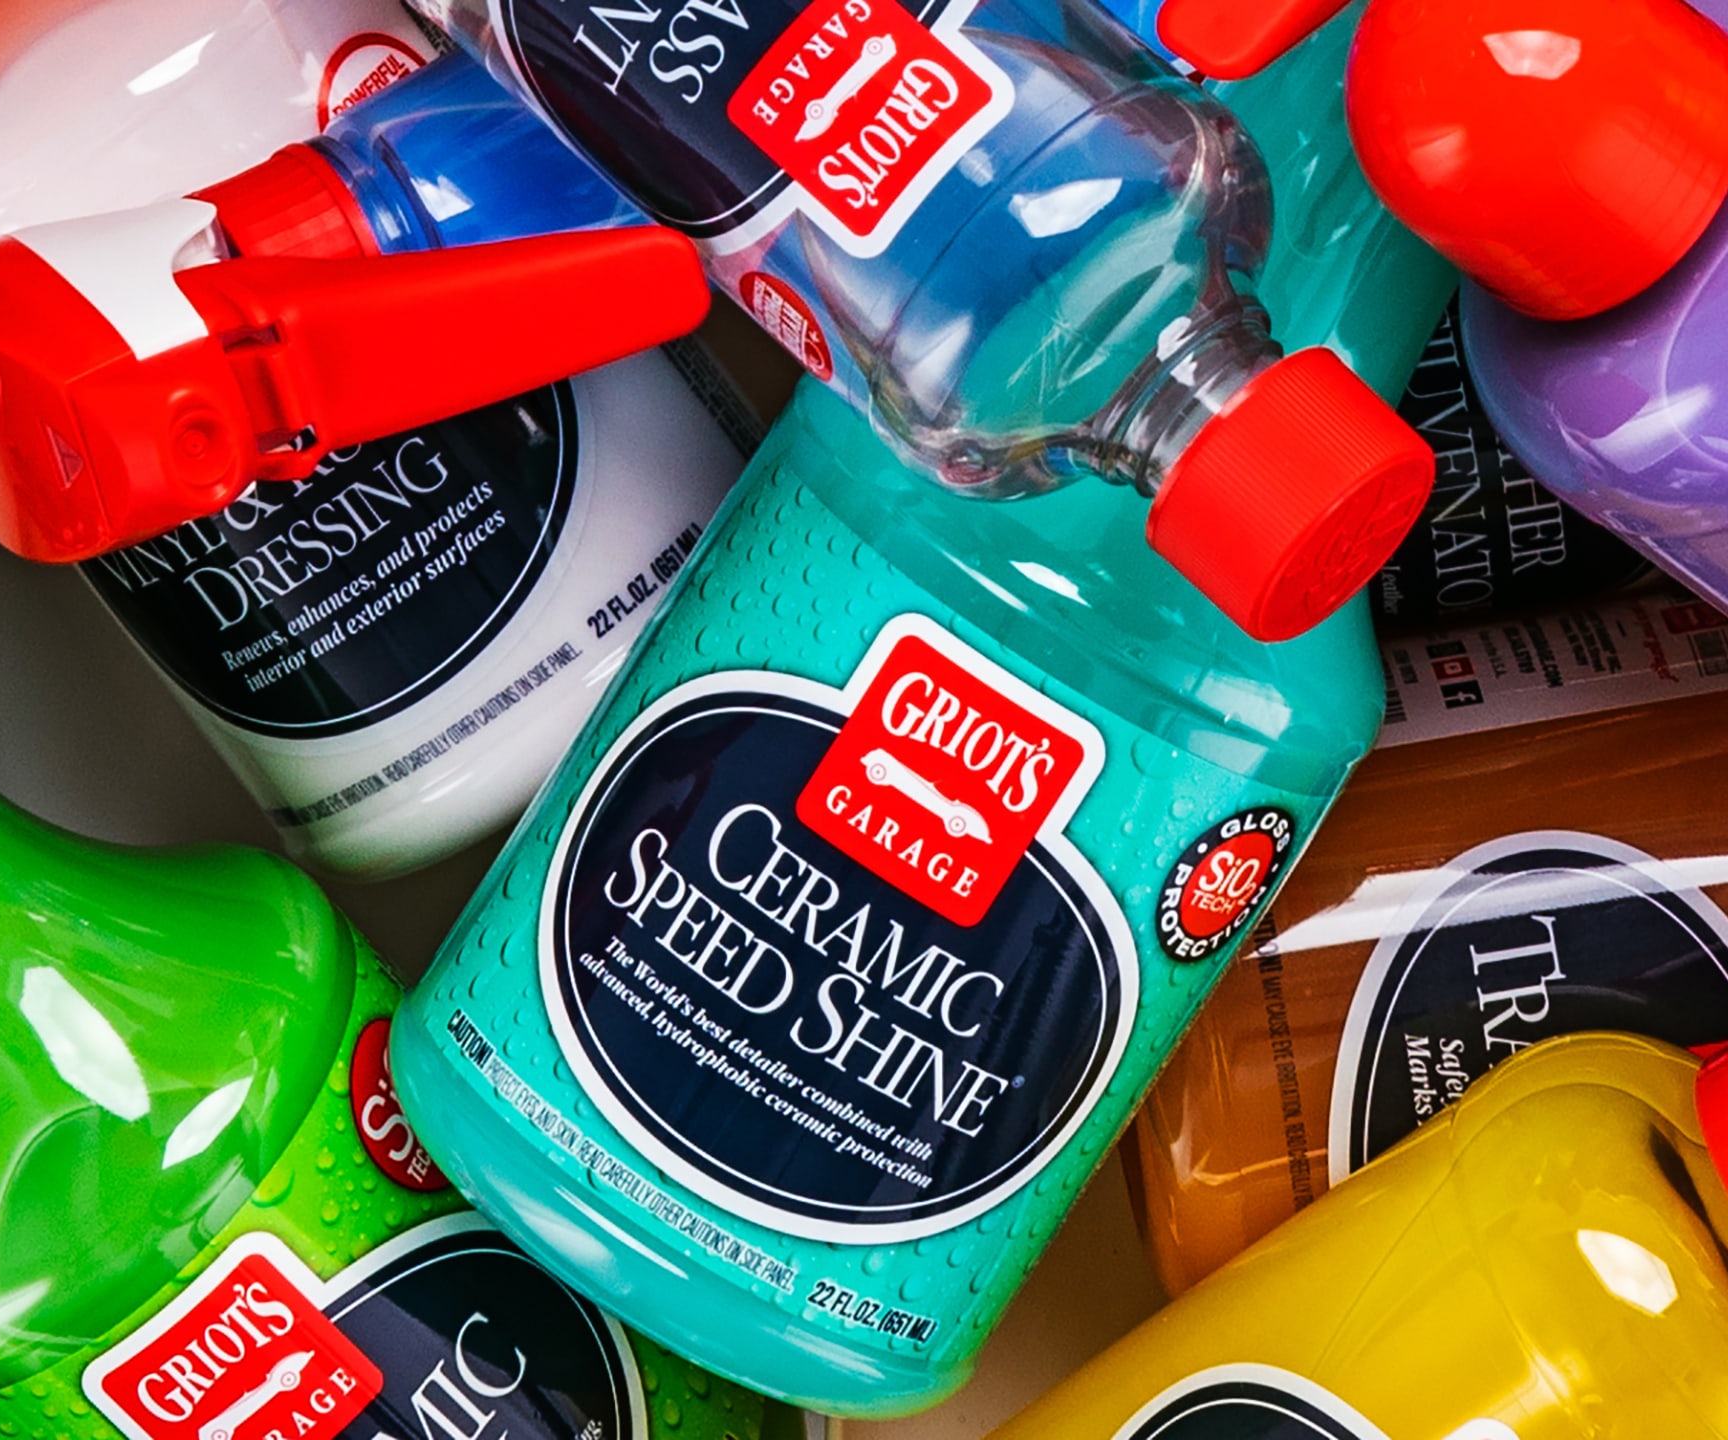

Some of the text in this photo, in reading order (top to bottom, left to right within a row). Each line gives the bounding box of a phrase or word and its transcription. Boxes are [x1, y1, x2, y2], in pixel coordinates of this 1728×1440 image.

[752, 0, 872, 125] GARAGE
[818, 58, 959, 208] GRIOT'S
[184, 437, 448, 631] DRESSING
[221, 479, 494, 672] Renews, enhances, and protects
[245, 507, 507, 693] interior and exterior surfaces
[587, 611, 613, 639] 22
[880, 671, 1055, 813] GRIOT'S
[826, 784, 980, 898] GARAGE
[1190, 890, 1235, 915] TECH
[1221, 812, 1290, 852] GLOSS
[604, 828, 794, 1014] SPEED
[708, 803, 1005, 1037] CERAMIC
[1162, 863, 1266, 957] PROTECTION
[579, 951, 933, 1189] advanced, hydrophobic ceramic protection
[604, 935, 934, 1161] The World's best detailer combined with
[1404, 1033, 1437, 1115] Marks
[447, 1008, 836, 1313] CAUTION! READ CAREFULLY OTHER CAUTIONS 22
[136, 1281, 295, 1423] GRIOT'S
